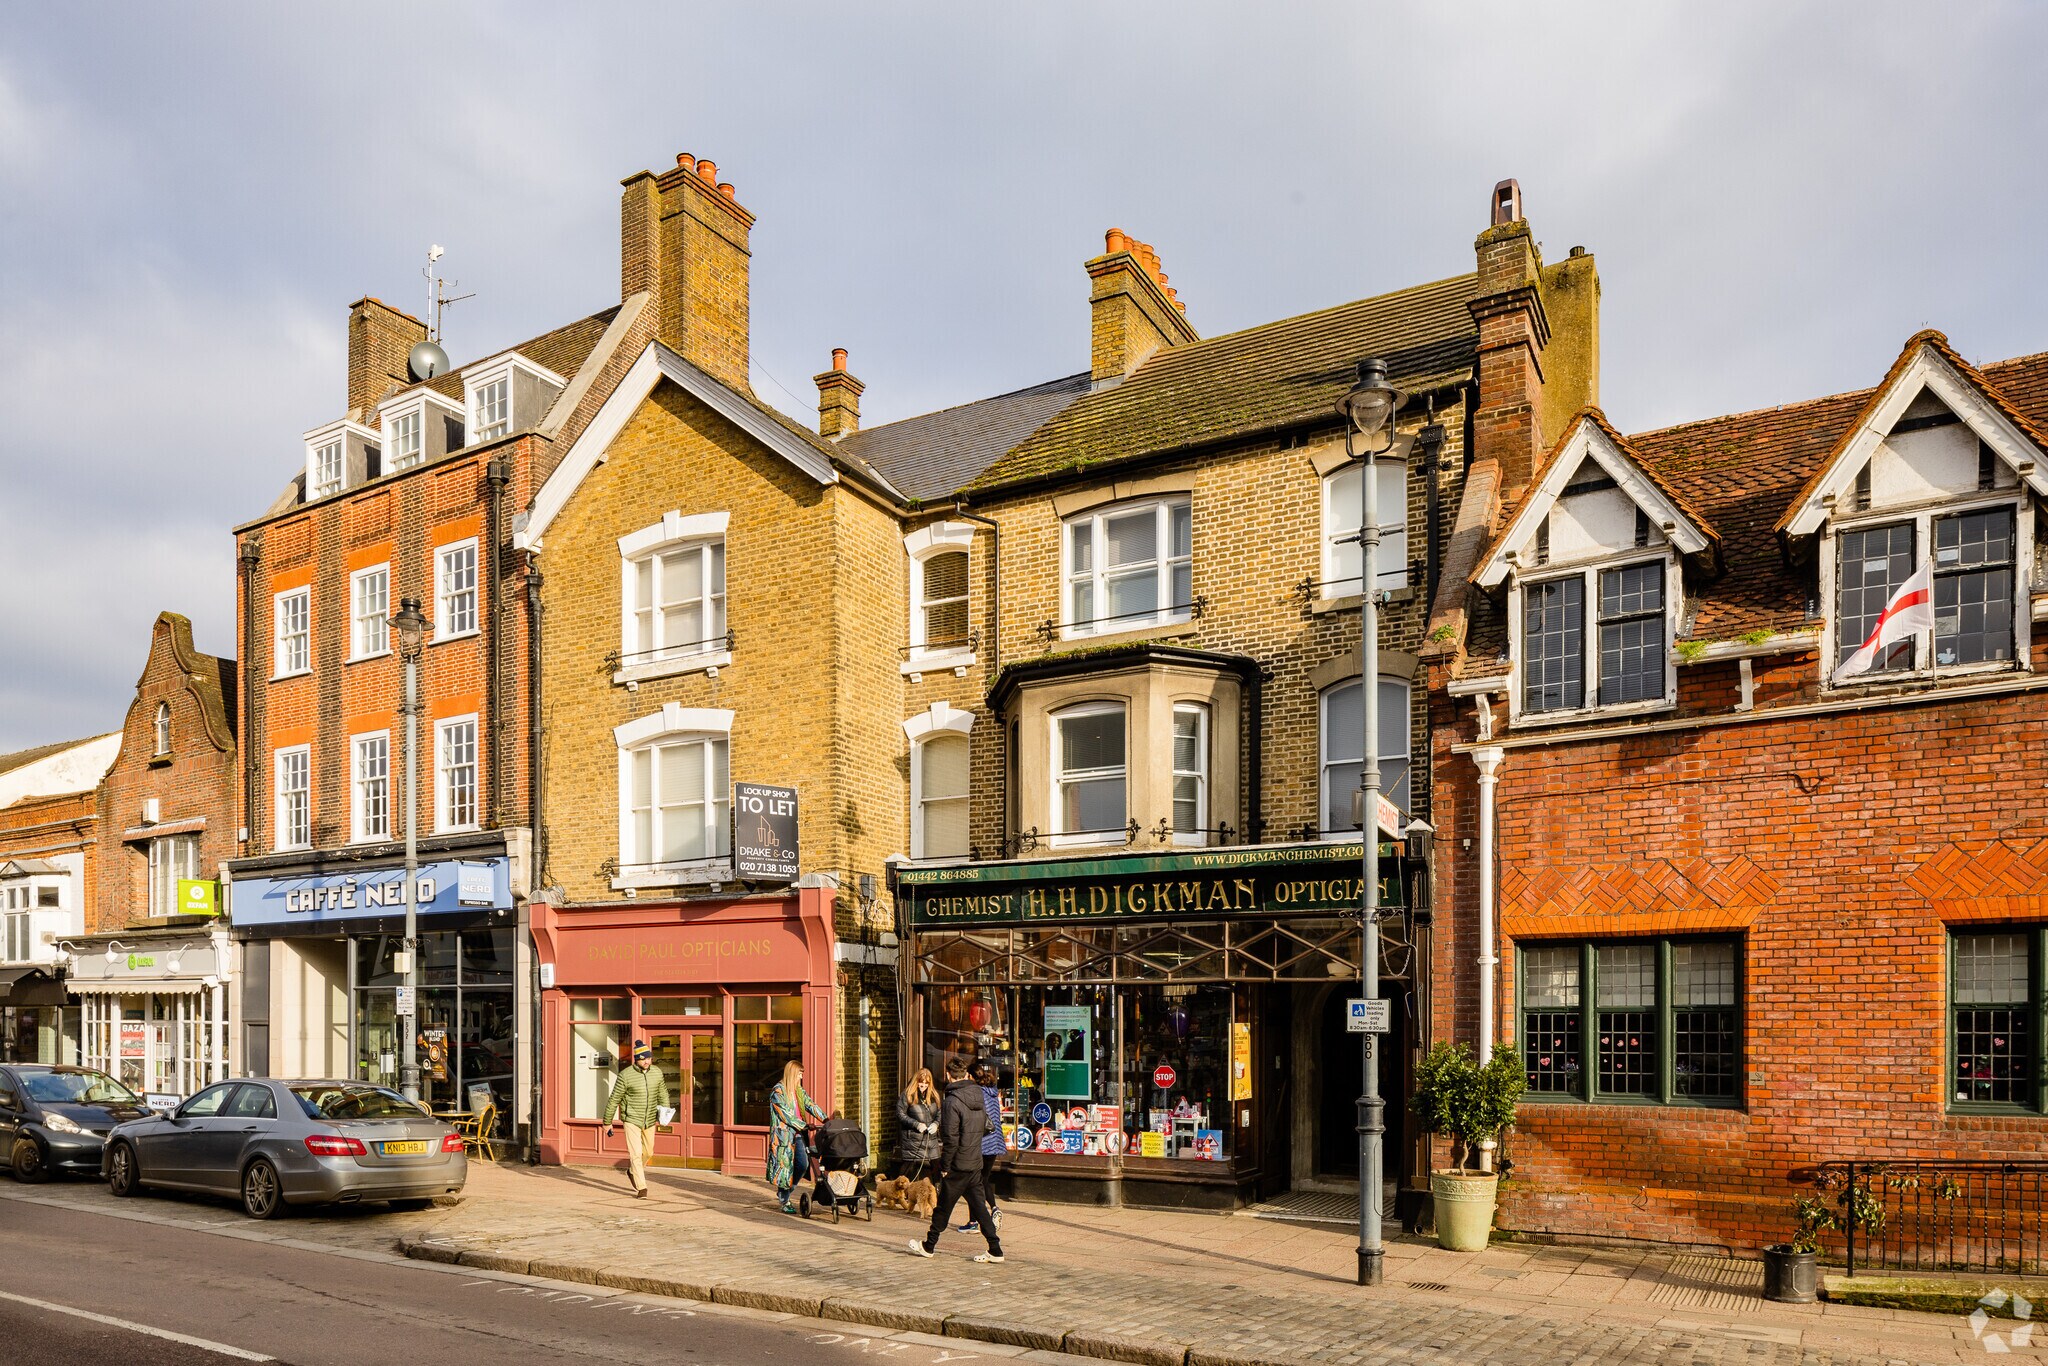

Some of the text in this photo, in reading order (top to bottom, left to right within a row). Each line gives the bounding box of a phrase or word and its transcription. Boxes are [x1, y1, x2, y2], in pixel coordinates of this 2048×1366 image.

[743, 787, 790, 799] LOCK UP SHOP
[739, 796, 795, 817] TO LET
[740, 846, 771, 858] DRAKE
[773, 849, 781, 858] &
[1193, 843, 1385, 866] WWW.DICKMANCHEMIST.COK
[740, 861, 797, 874] 020 7138 1053
[907, 869, 979, 882] 01442 864885
[461, 884, 491, 894] NERO
[186, 901, 209, 909] OXFAM
[925, 895, 1013, 917] CHEMIST
[588, 938, 771, 961] DAVID PAUL OPTICIANS
[122, 1024, 145, 1032] GAZA
[423, 1030, 445, 1038] WINTER
[1155, 1073, 1174, 1081] STOP
[387, 1142, 424, 1152] KN13 HBJ
